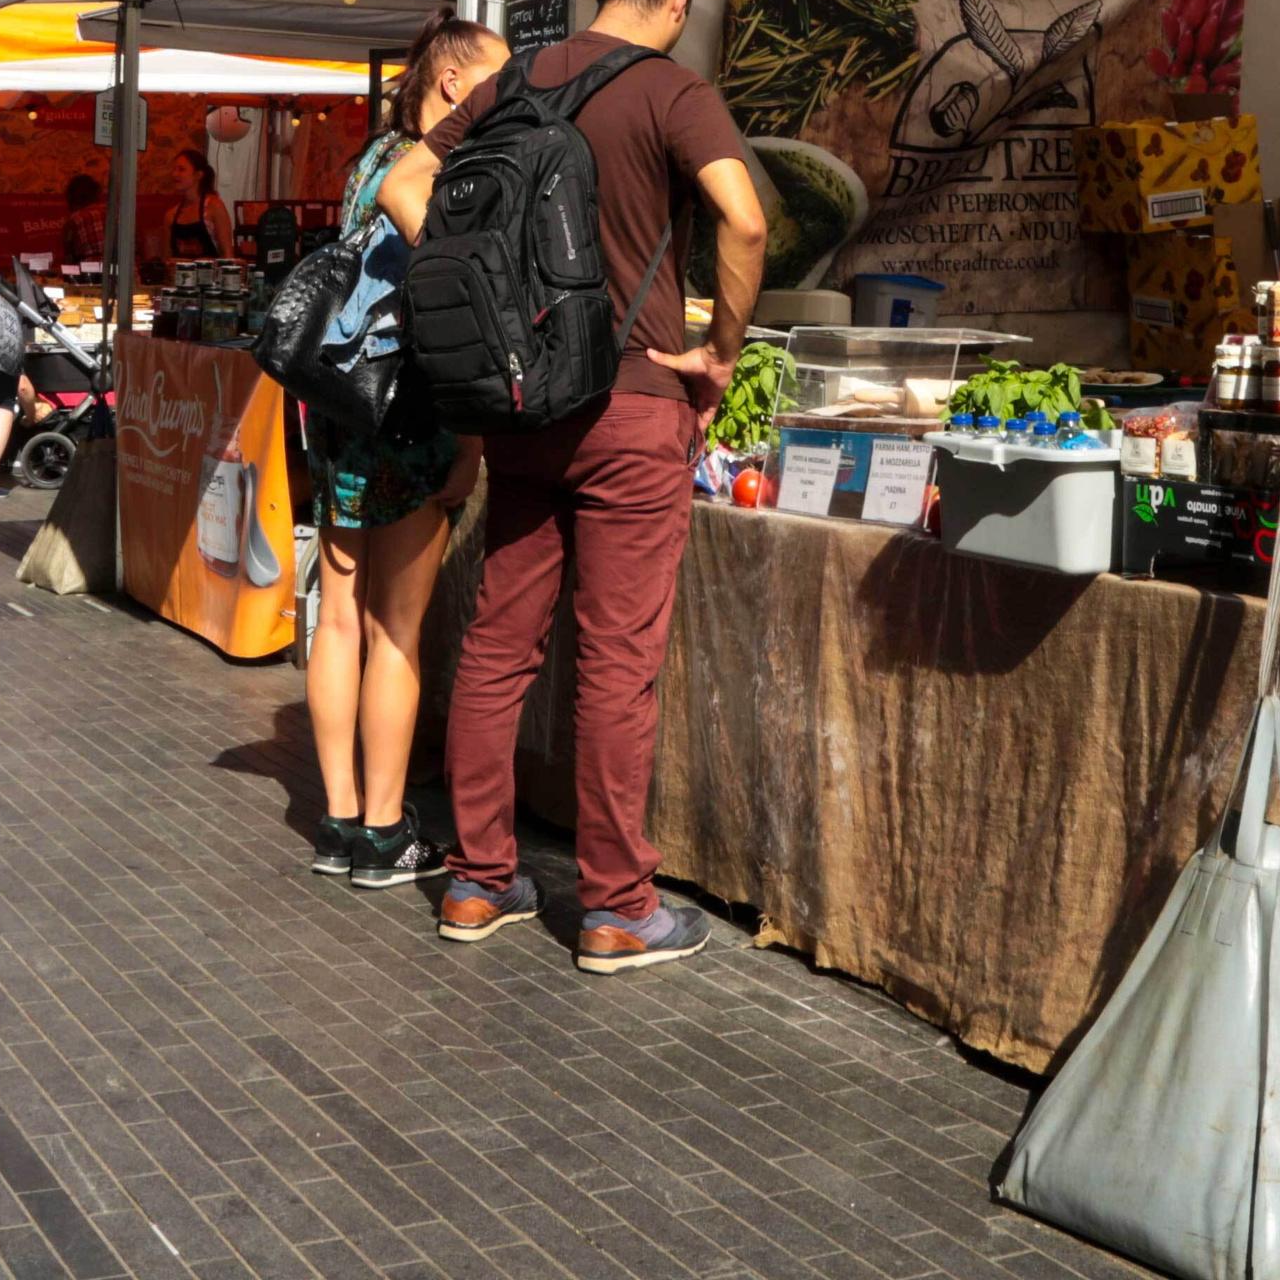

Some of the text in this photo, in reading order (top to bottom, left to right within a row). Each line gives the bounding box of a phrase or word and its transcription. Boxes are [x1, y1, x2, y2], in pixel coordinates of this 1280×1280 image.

[946, 191, 1080, 214] PEPERONCIN
[913, 443, 931, 454] PESTO
[885, 457, 921, 468] MOZZARELLA
